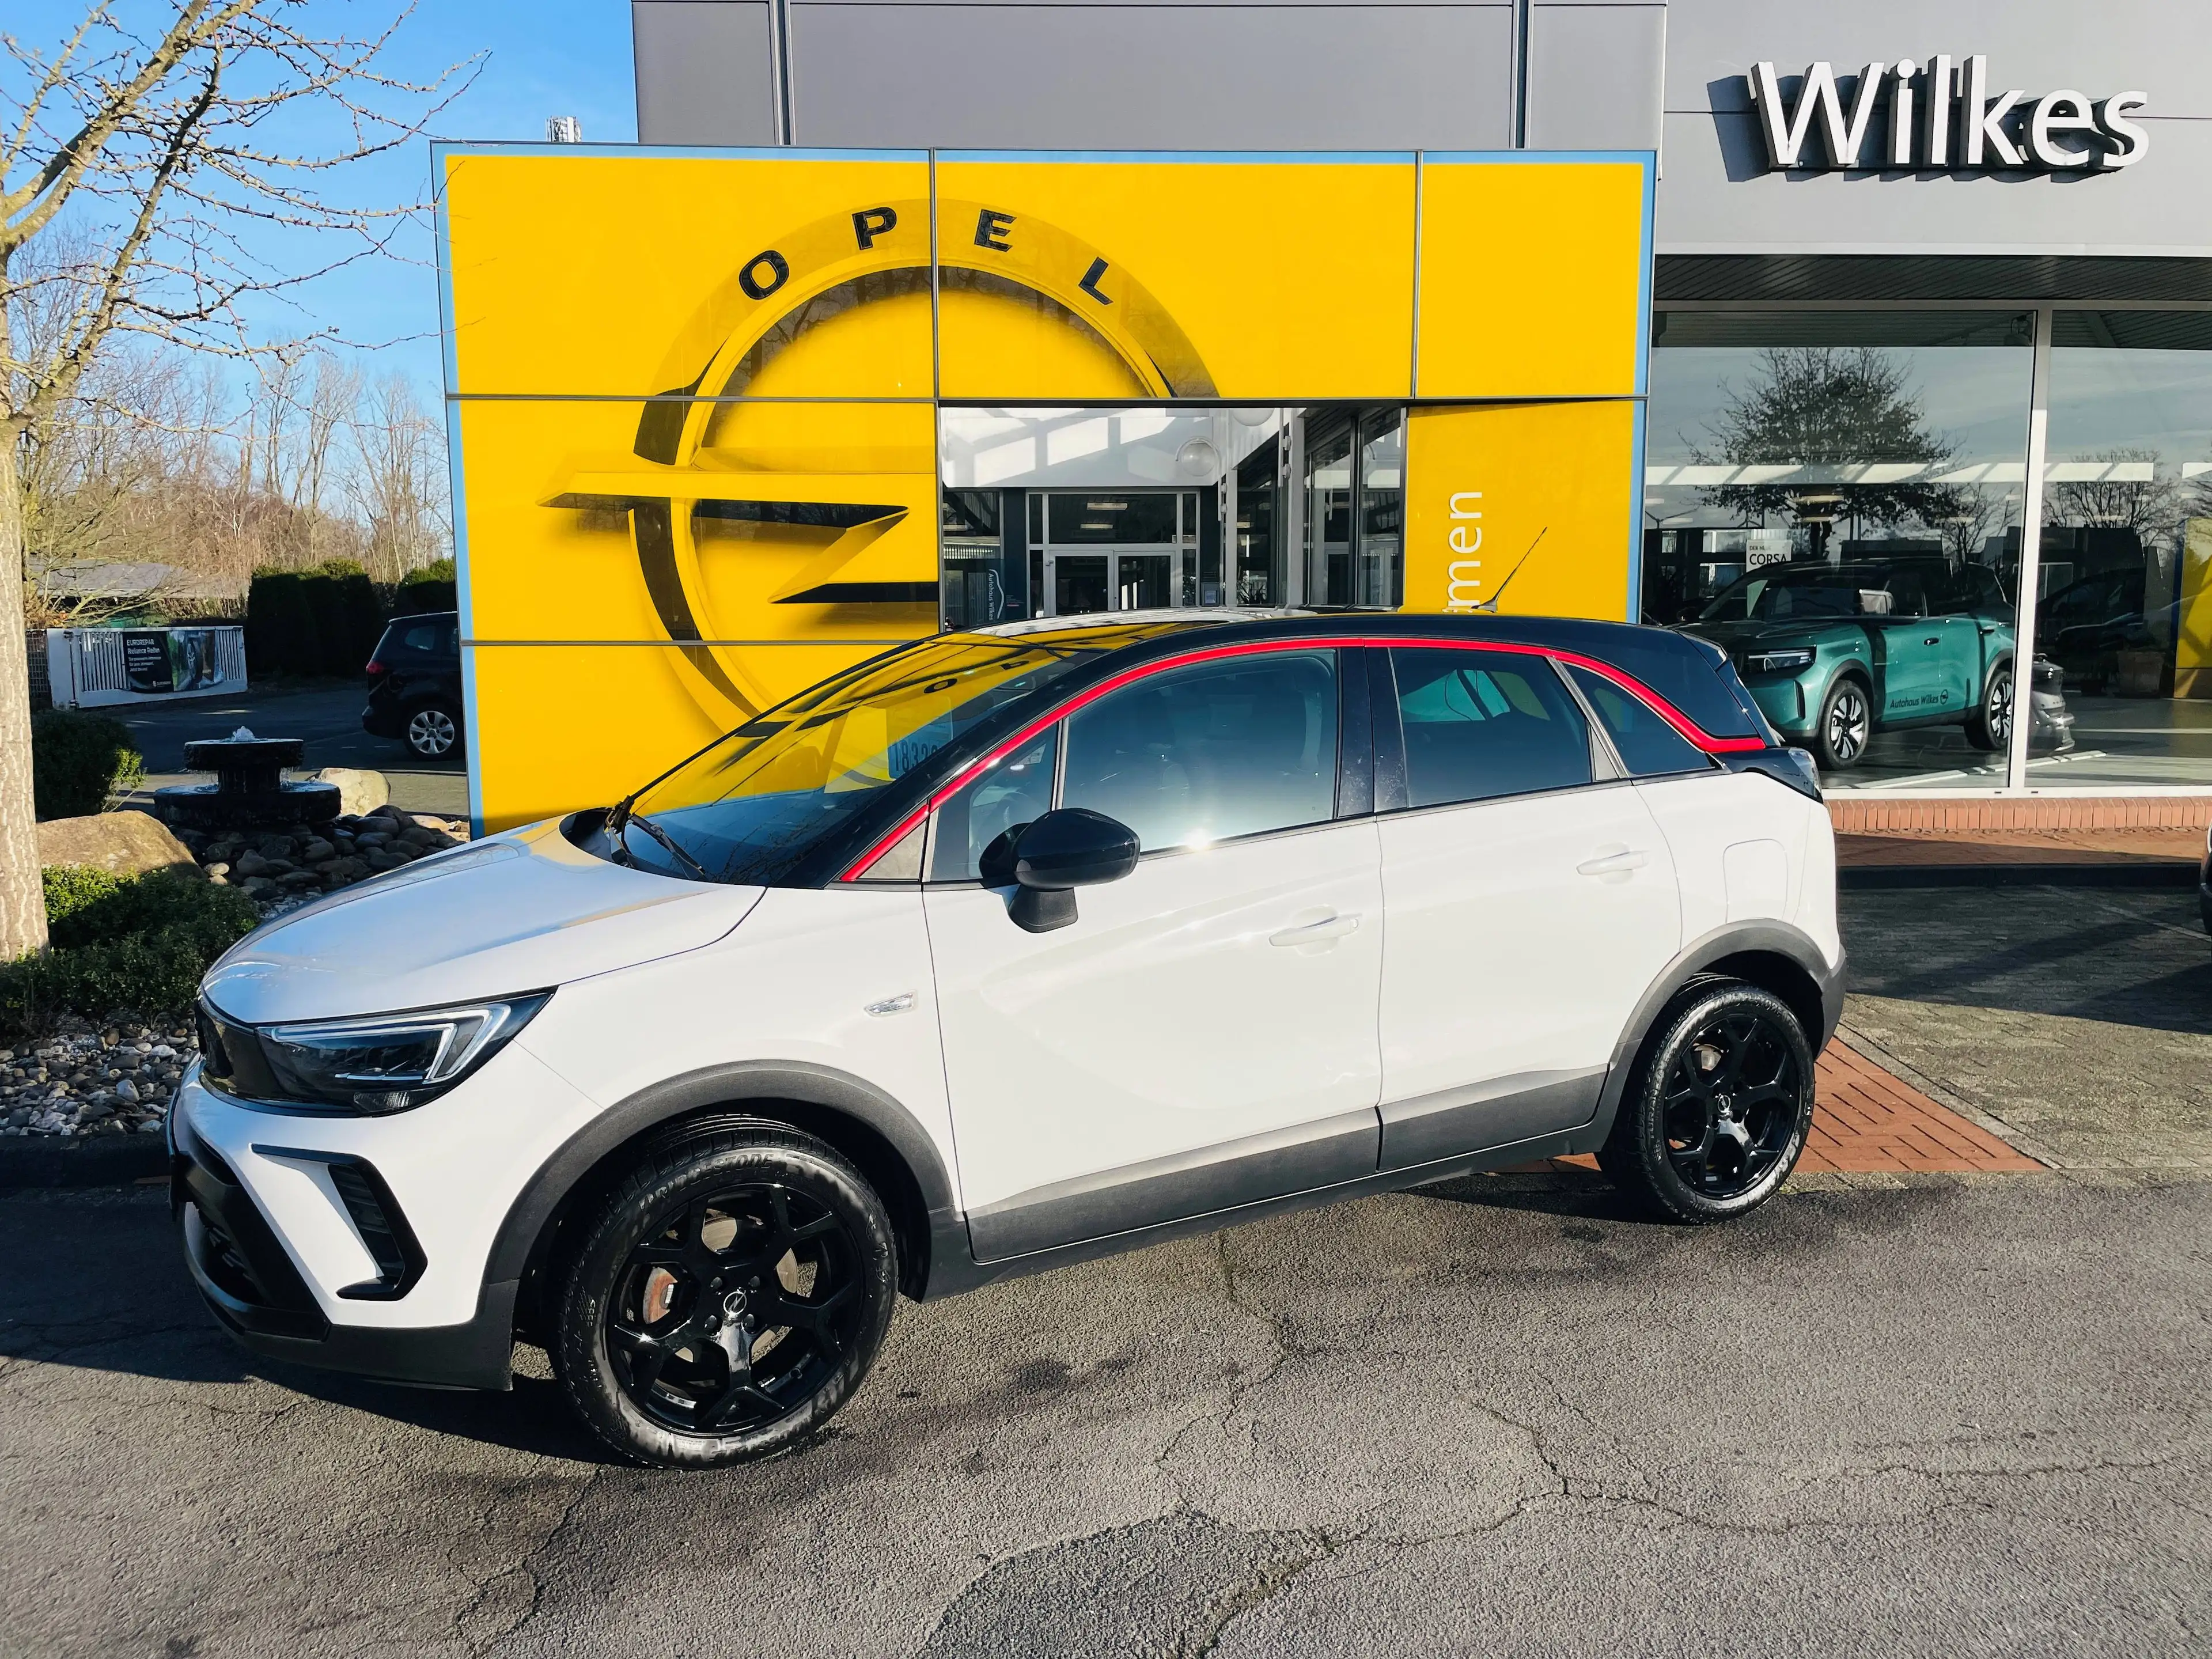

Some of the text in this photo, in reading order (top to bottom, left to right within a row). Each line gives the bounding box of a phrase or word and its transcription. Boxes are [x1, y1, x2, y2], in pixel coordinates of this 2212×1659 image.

[1752, 54, 2149, 168] Wilkes
[739, 207, 1113, 306] OPEL
[1749, 554, 1787, 565] CORSA
[1890, 694, 1939, 708] Autohaus Wilkes
